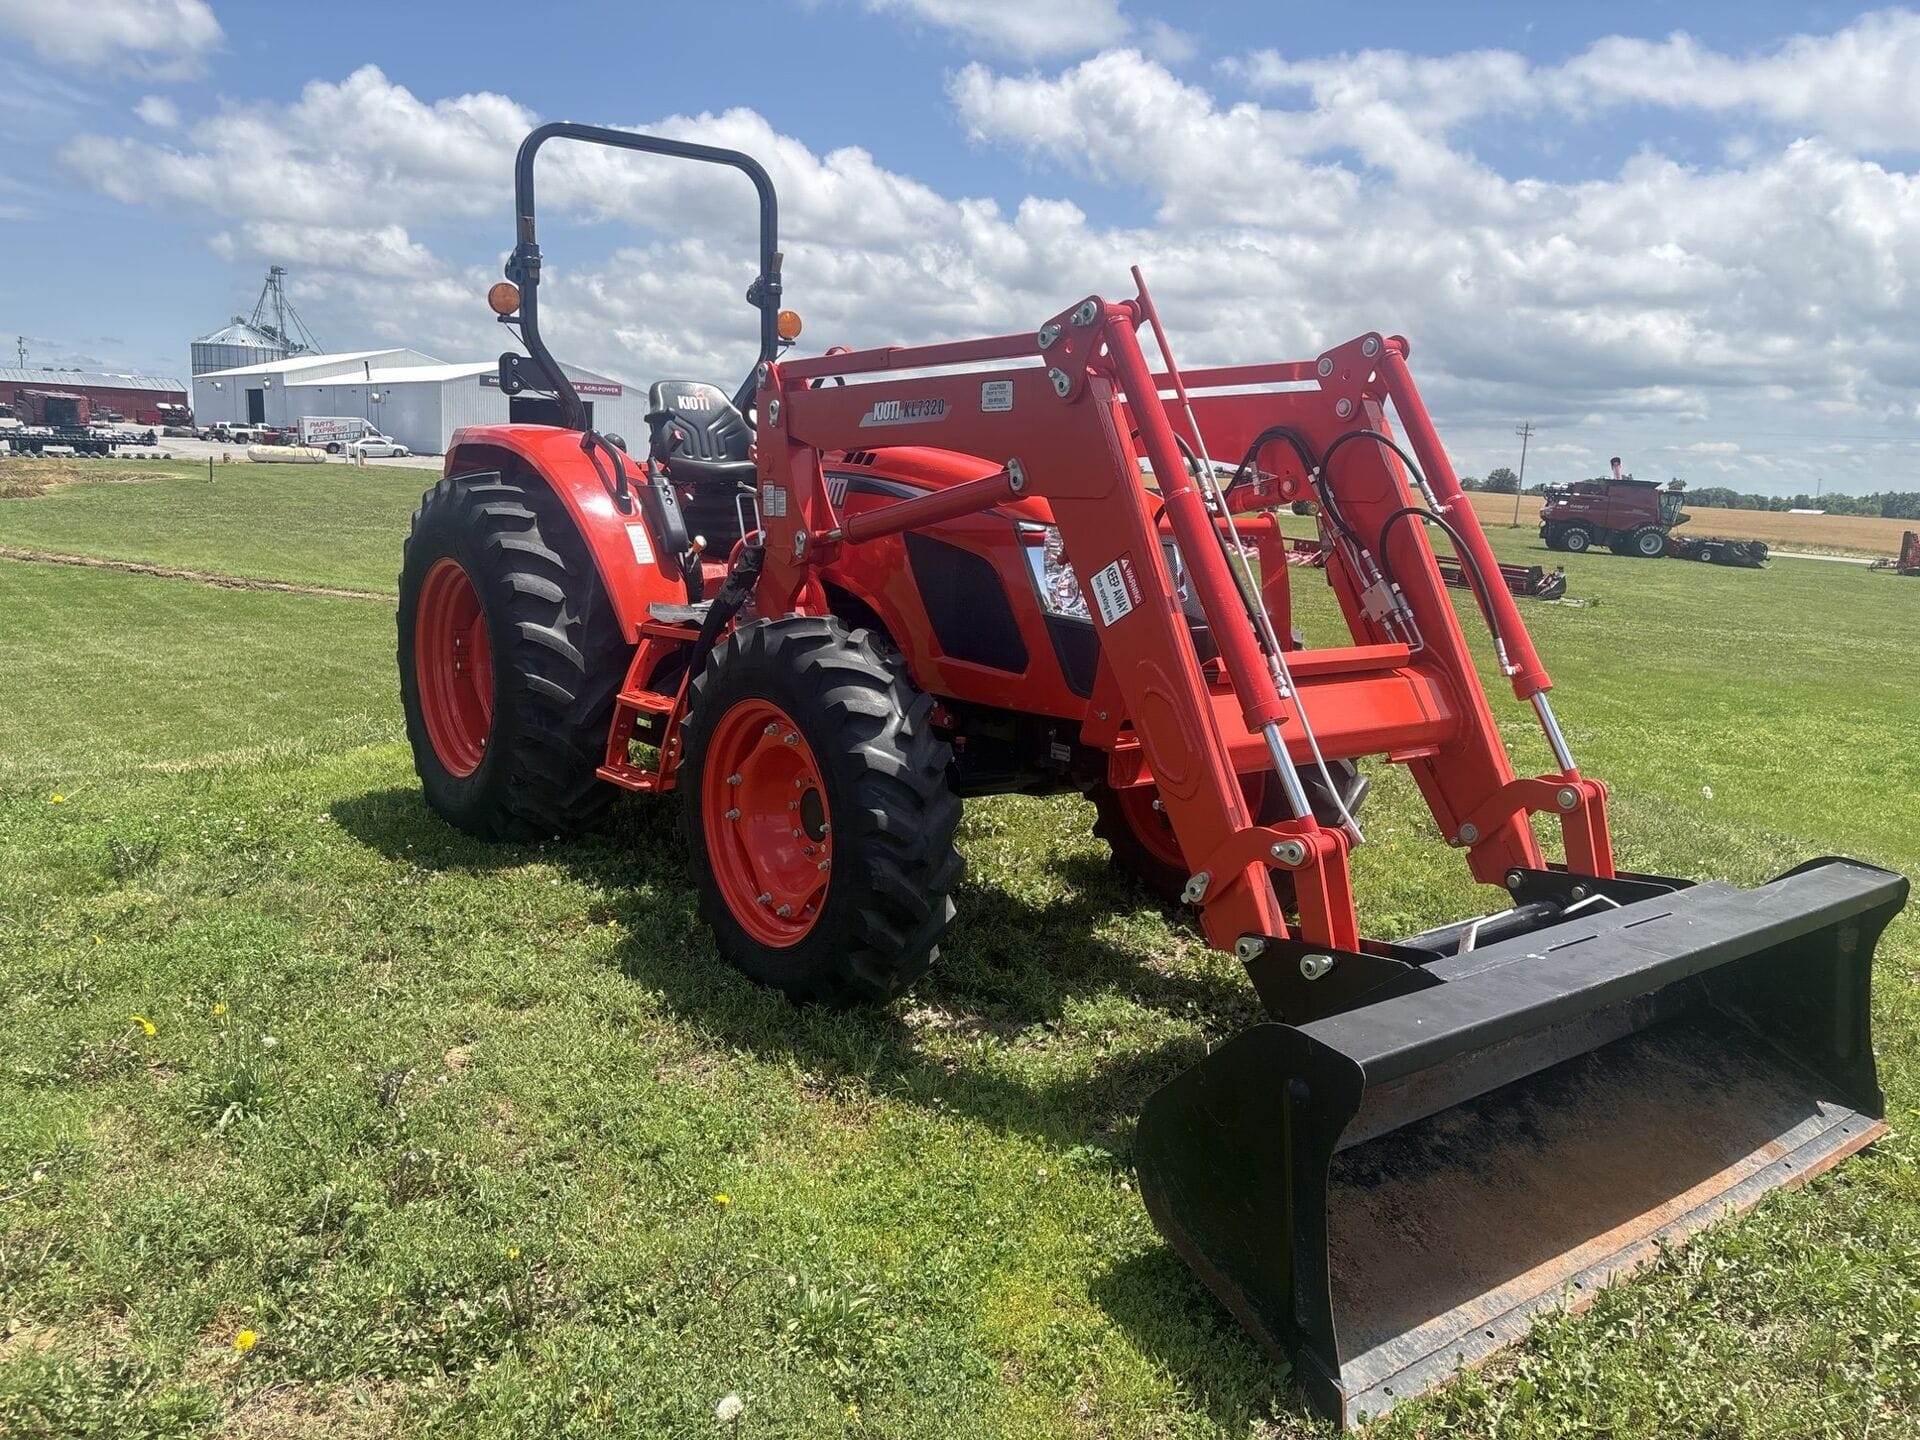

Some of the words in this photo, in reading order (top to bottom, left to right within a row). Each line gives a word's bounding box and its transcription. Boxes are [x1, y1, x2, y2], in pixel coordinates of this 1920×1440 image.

[677, 395, 710, 410] KIOTI
[874, 400, 900, 420] KIOTI
[903, 399, 945, 418] KL7320
[313, 426, 348, 434] EXPRESS
[1105, 565, 1120, 588] KEEP
[1125, 567, 1141, 604] WARNING
[1112, 588, 1128, 613] AWAY
